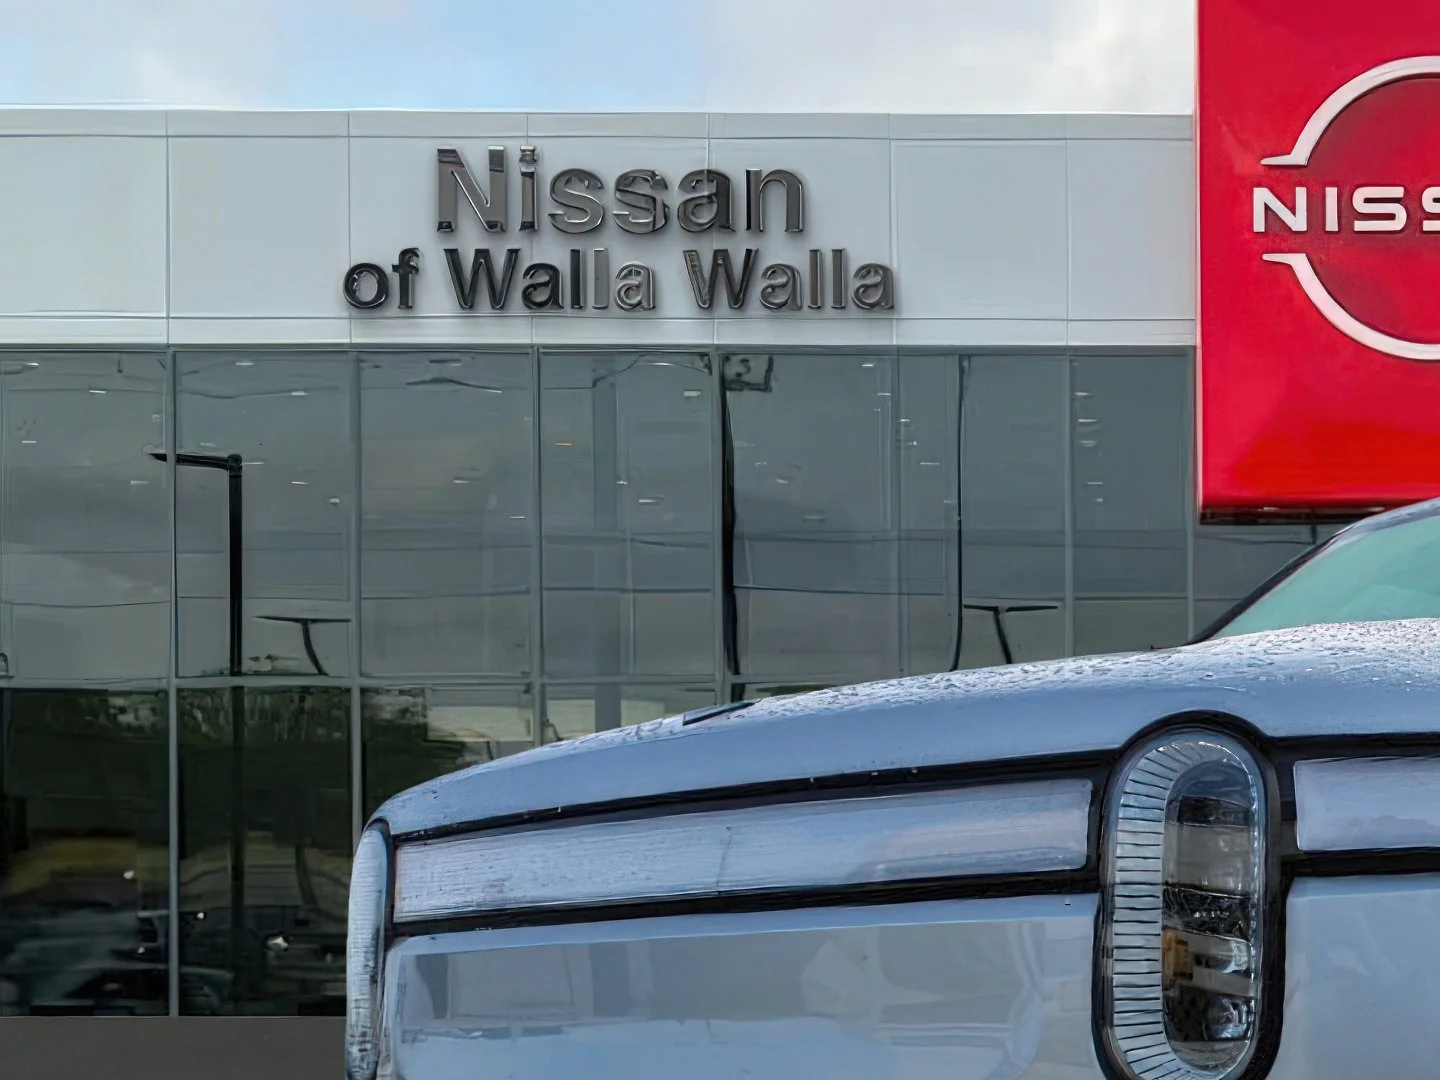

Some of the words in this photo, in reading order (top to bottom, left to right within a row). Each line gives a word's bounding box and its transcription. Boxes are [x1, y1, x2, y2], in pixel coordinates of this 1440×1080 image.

[436, 144, 807, 235] Nissan
[342, 247, 422, 310] of
[443, 247, 657, 311] Walla
[682, 247, 895, 311] Walla
